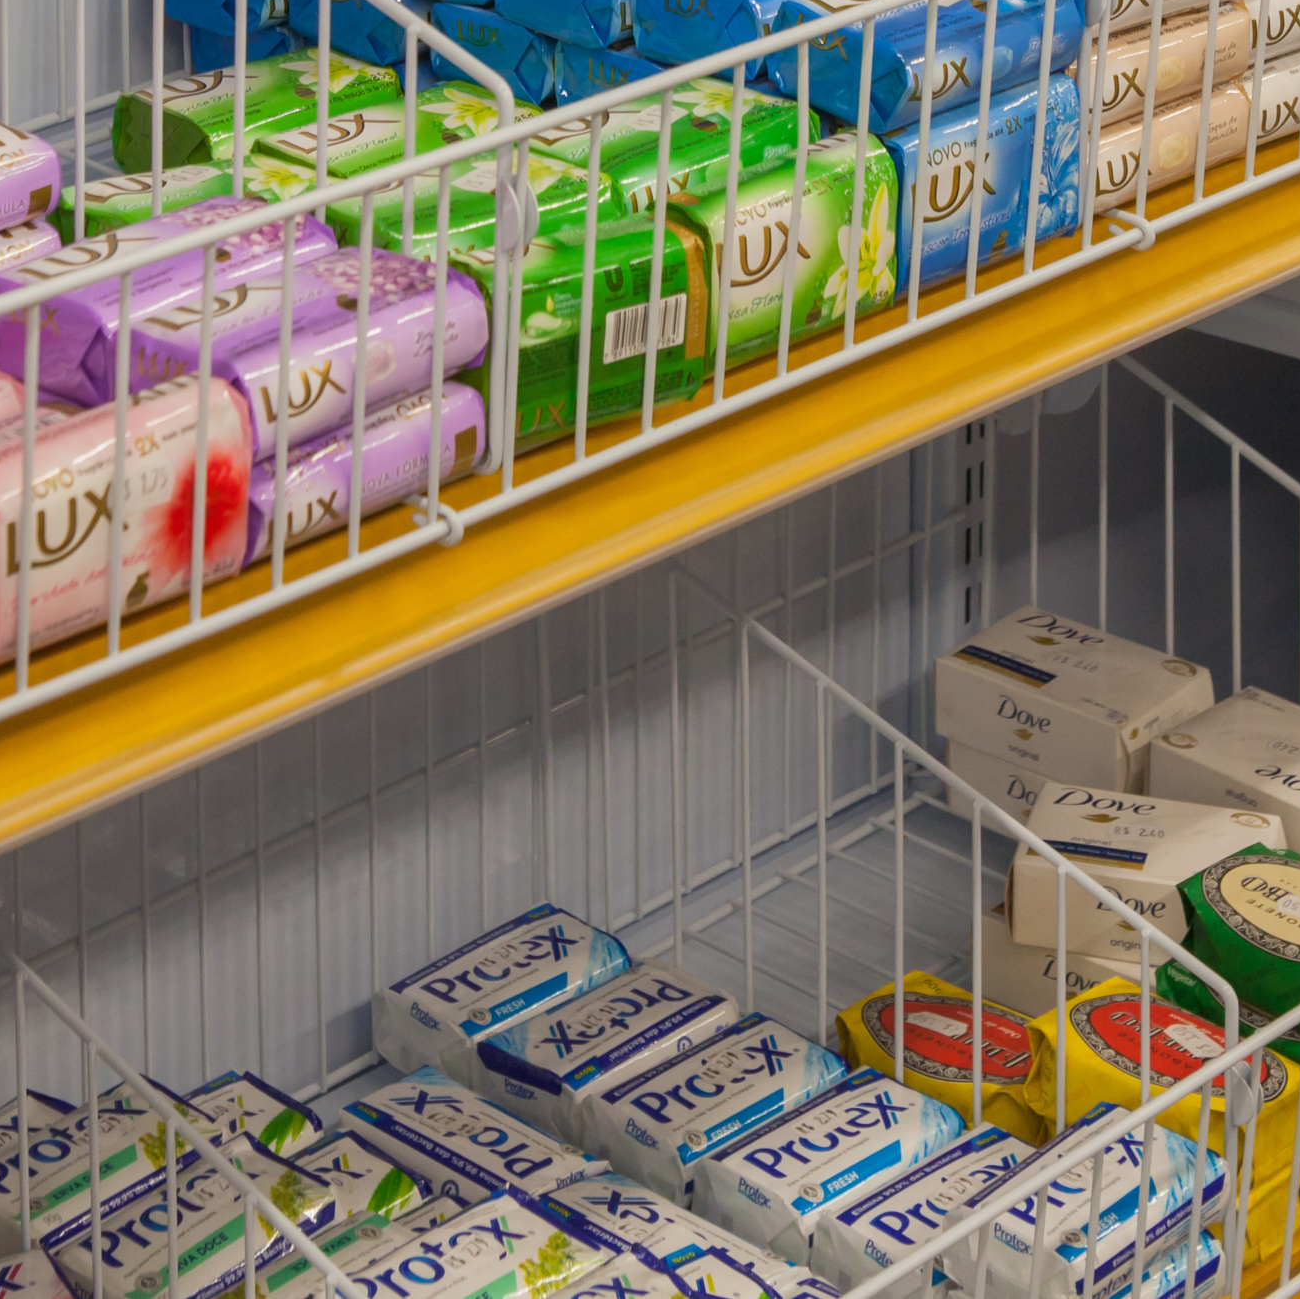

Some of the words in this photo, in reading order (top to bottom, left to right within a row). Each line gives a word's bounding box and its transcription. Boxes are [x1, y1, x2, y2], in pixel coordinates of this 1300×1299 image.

[456, 18, 505, 51] LUX
[137, 70, 260, 103] LUX
[588, 58, 631, 87] LUX
[910, 56, 972, 101] LUX
[277, 113, 402, 156] LUX
[911, 153, 996, 223] LUX
[714, 219, 811, 288] LUX
[137, 345, 189, 383] LUX
[259, 359, 347, 424] LUX
[6, 485, 129, 576] LUX
[267, 489, 339, 553] LUX
[1014, 614, 1106, 650] Dove
[995, 694, 1053, 735] Dove
[1051, 785, 1159, 817] Dove
[1094, 883, 1169, 920] Dove
[409, 1001, 441, 1031] Protex
[502, 1077, 538, 1101] Protex
[624, 1118, 660, 1150] Protex
[625, 1118, 659, 1149] Protex
[555, 1167, 589, 1189] Protex
[737, 1175, 772, 1210] Protex
[826, 1170, 860, 1195] FRESH
[849, 1198, 883, 1222] Elimina
[923, 1150, 962, 1177] Bactérias
[992, 1221, 1032, 1256] Protex
